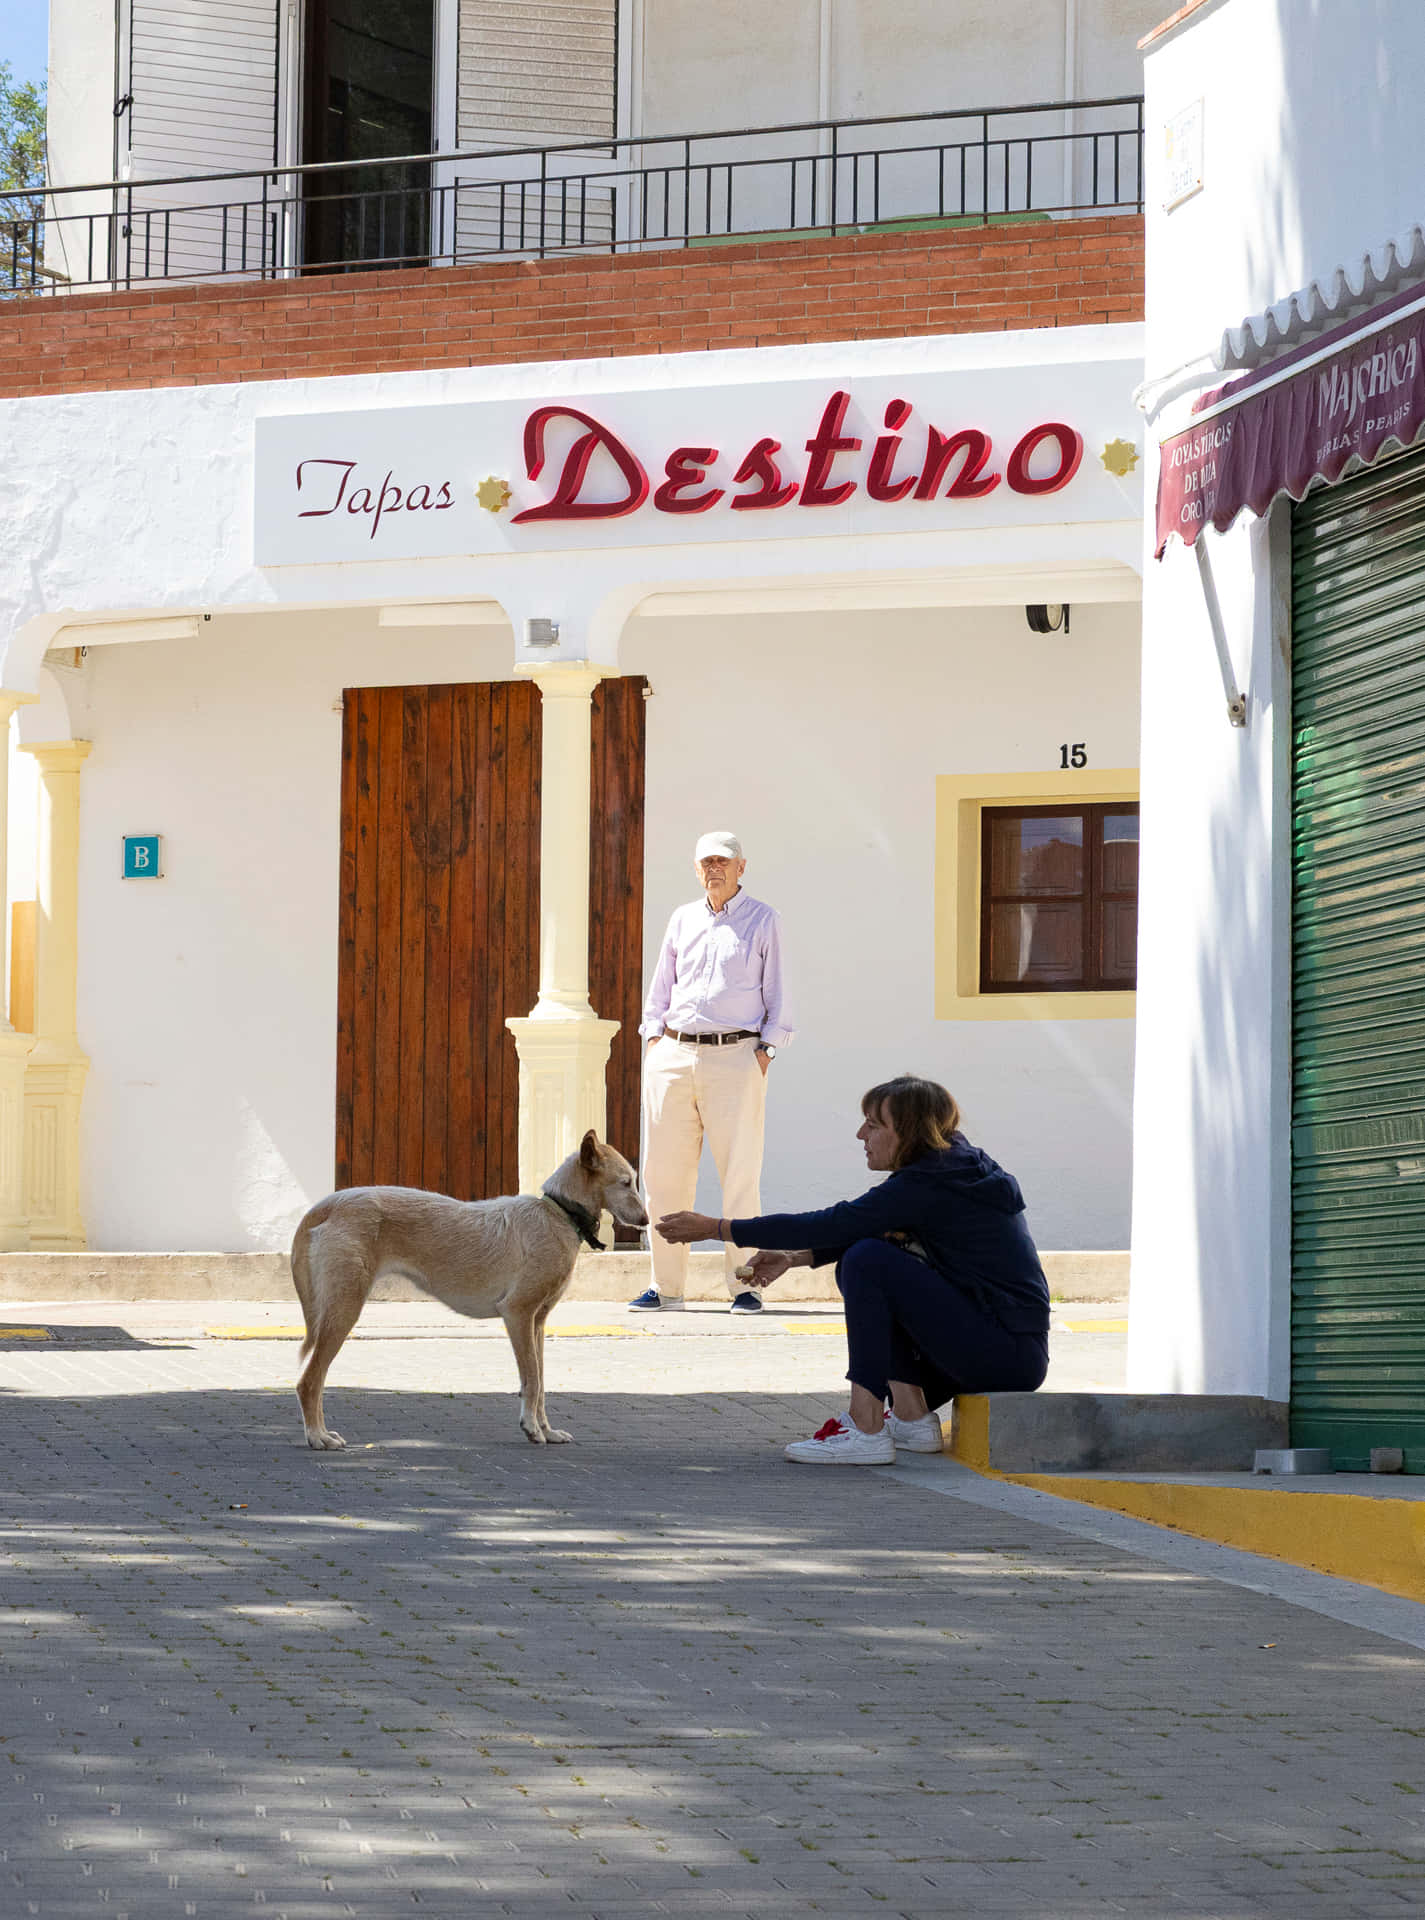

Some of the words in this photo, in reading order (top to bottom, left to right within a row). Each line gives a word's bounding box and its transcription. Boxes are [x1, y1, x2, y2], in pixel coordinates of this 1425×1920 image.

[296, 459, 456, 540] Tapas
[510, 390, 1084, 524] Destino
[1169, 439, 1200, 469] JOYAS
[1184, 469, 1198, 495] DE
[1059, 742, 1088, 769] 15
[134, 846, 150, 868] B
